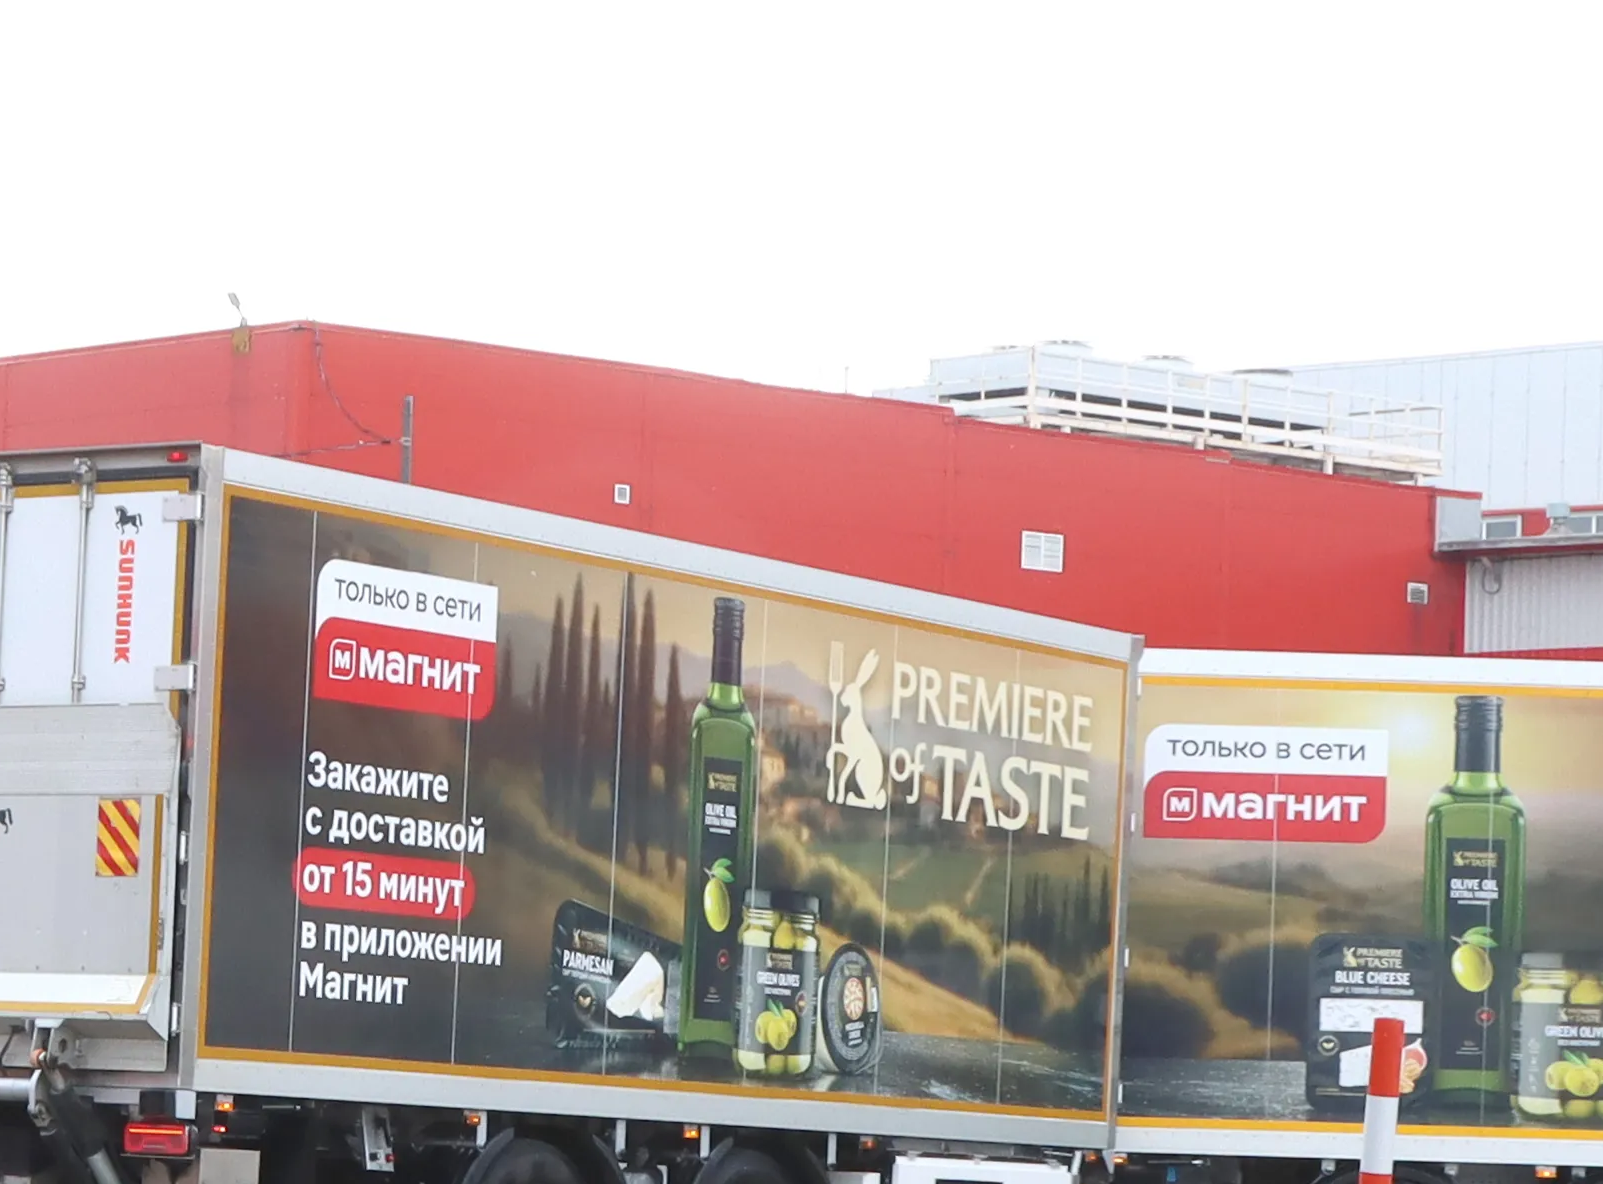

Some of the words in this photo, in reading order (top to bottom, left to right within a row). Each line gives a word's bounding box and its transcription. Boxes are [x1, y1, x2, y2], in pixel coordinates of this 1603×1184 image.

[114, 539, 136, 664] SUNHUNK
[334, 578, 410, 610] только
[415, 592, 428, 613] в
[433, 595, 481, 622] сети
[891, 661, 1093, 753] PREMIERE
[1166, 739, 1267, 759] только
[1276, 741, 1291, 759] в
[1299, 742, 1366, 761] сети
[307, 750, 449, 803] Закажите
[889, 742, 927, 805] of
[932, 744, 1090, 841] TASTE
[305, 806, 323, 835] с
[328, 808, 485, 854] доставкой
[302, 863, 336, 894] от
[342, 860, 373, 898] 15
[378, 871, 466, 915] минут
[300, 920, 317, 949] в
[324, 922, 502, 966] приложении
[562, 949, 614, 976] PARMESAN
[299, 960, 409, 1005] Магнит
[1335, 970, 1364, 984] BLUE
[1366, 971, 1411, 985] CHEESE
